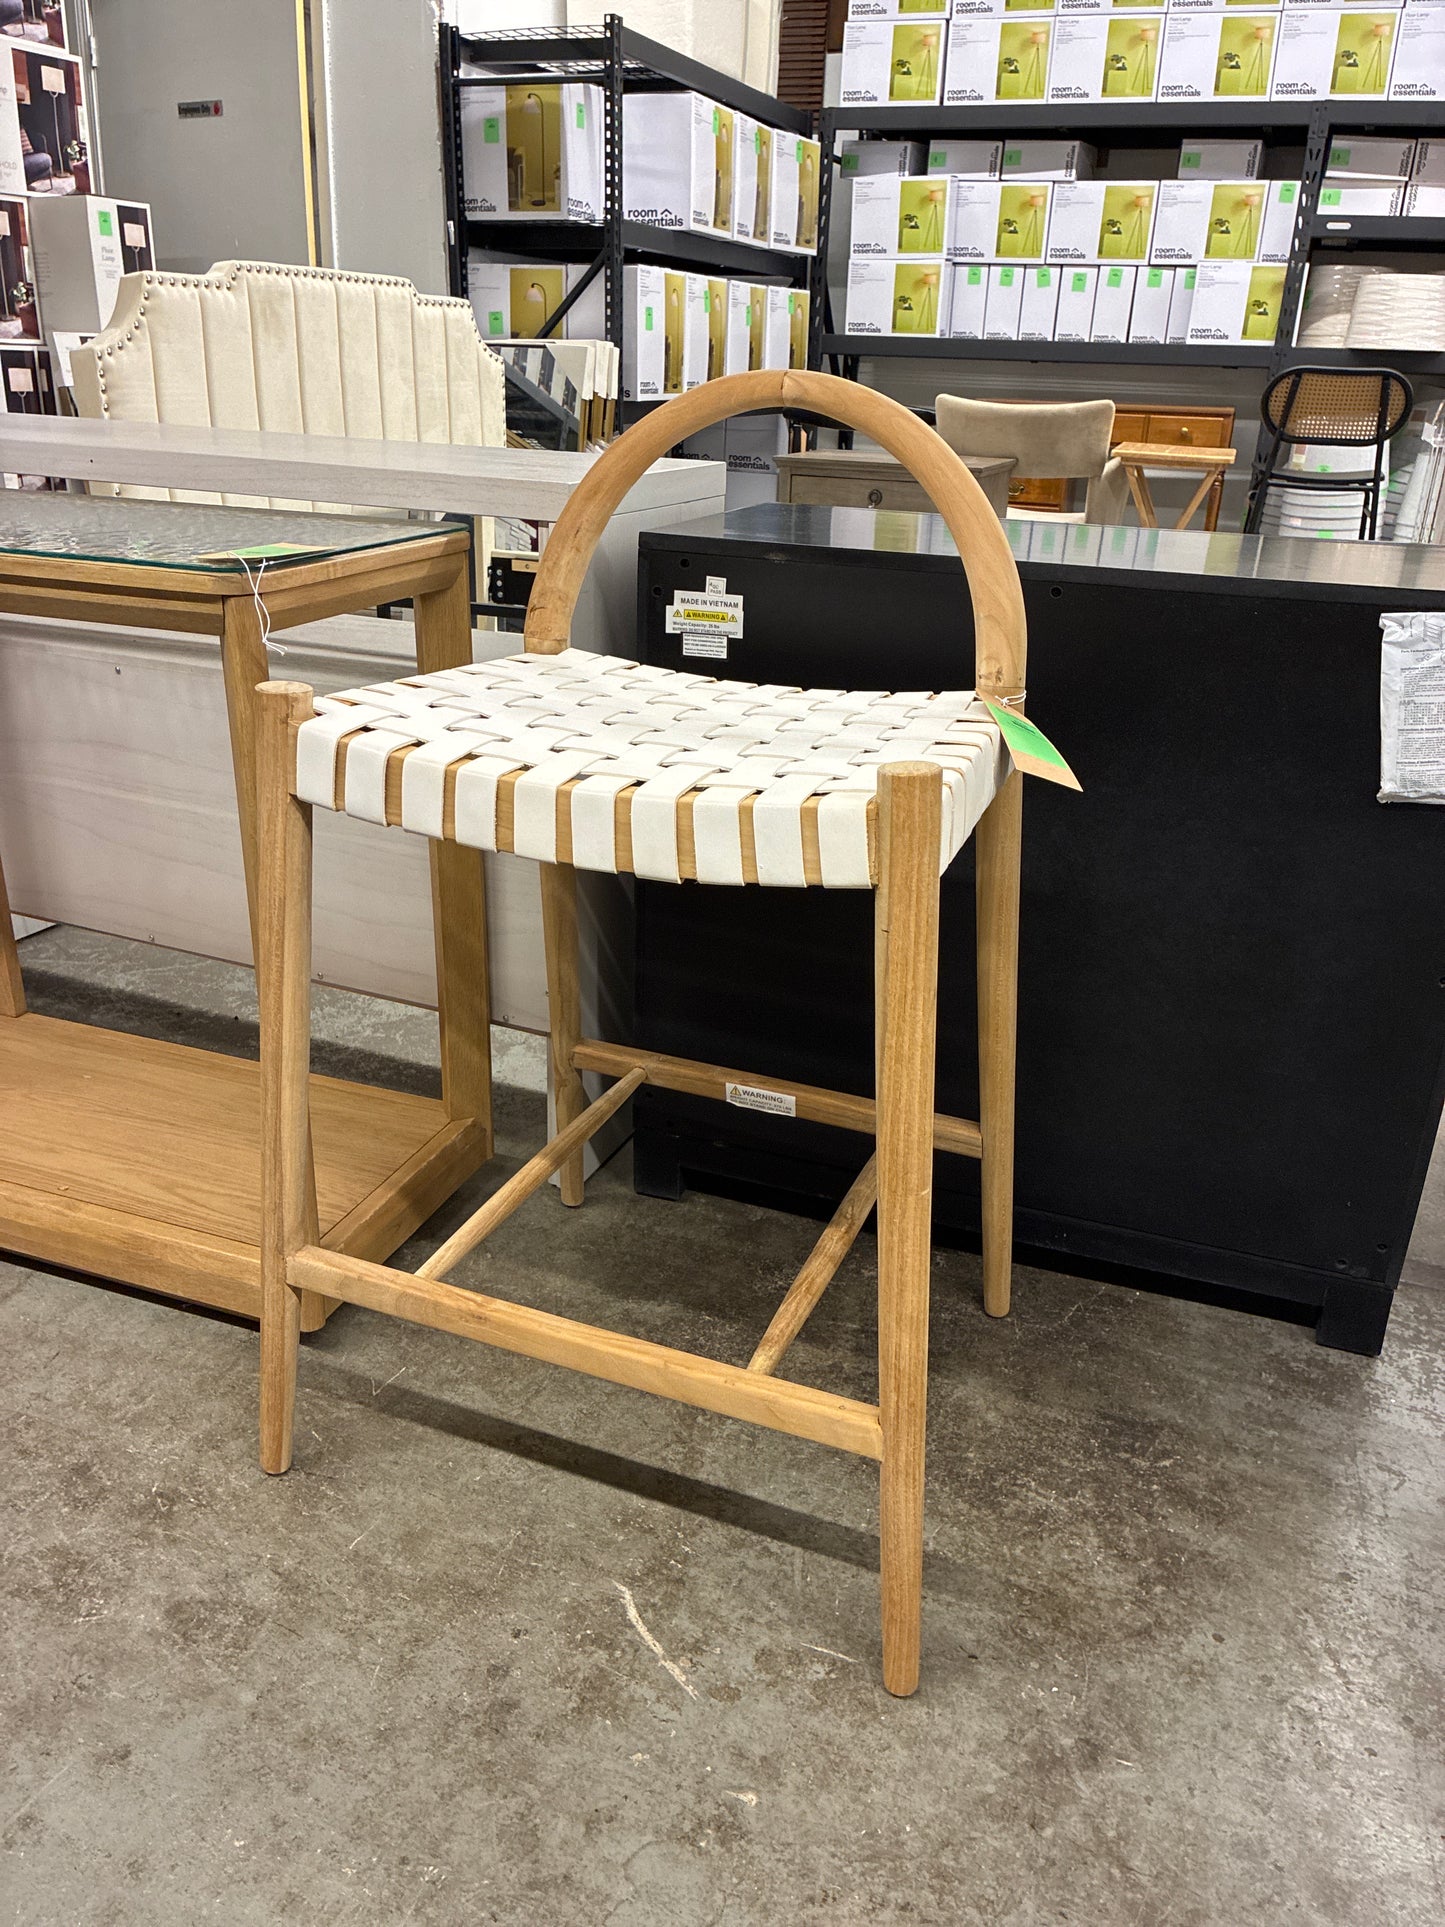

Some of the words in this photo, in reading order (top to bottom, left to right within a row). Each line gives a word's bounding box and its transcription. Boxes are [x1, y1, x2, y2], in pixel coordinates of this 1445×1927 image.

[955, 6, 993, 14] essentials
[1051, 91, 1089, 99] essentials
[1160, 89, 1201, 97] essentials
[1275, 87, 1317, 95] essentials
[1393, 88, 1436, 96] essentials
[842, 94, 878, 102] essentials
[568, 198, 584, 209] room
[628, 208, 658, 218] room
[1190, 332, 1230, 340] essentials
[728, 454, 752, 462] room
[728, 461, 770, 470] essentials
[680, 597, 699, 605] MADE
[709, 600, 739, 608] VIETNAM
[691, 612, 720, 620] WARNING
